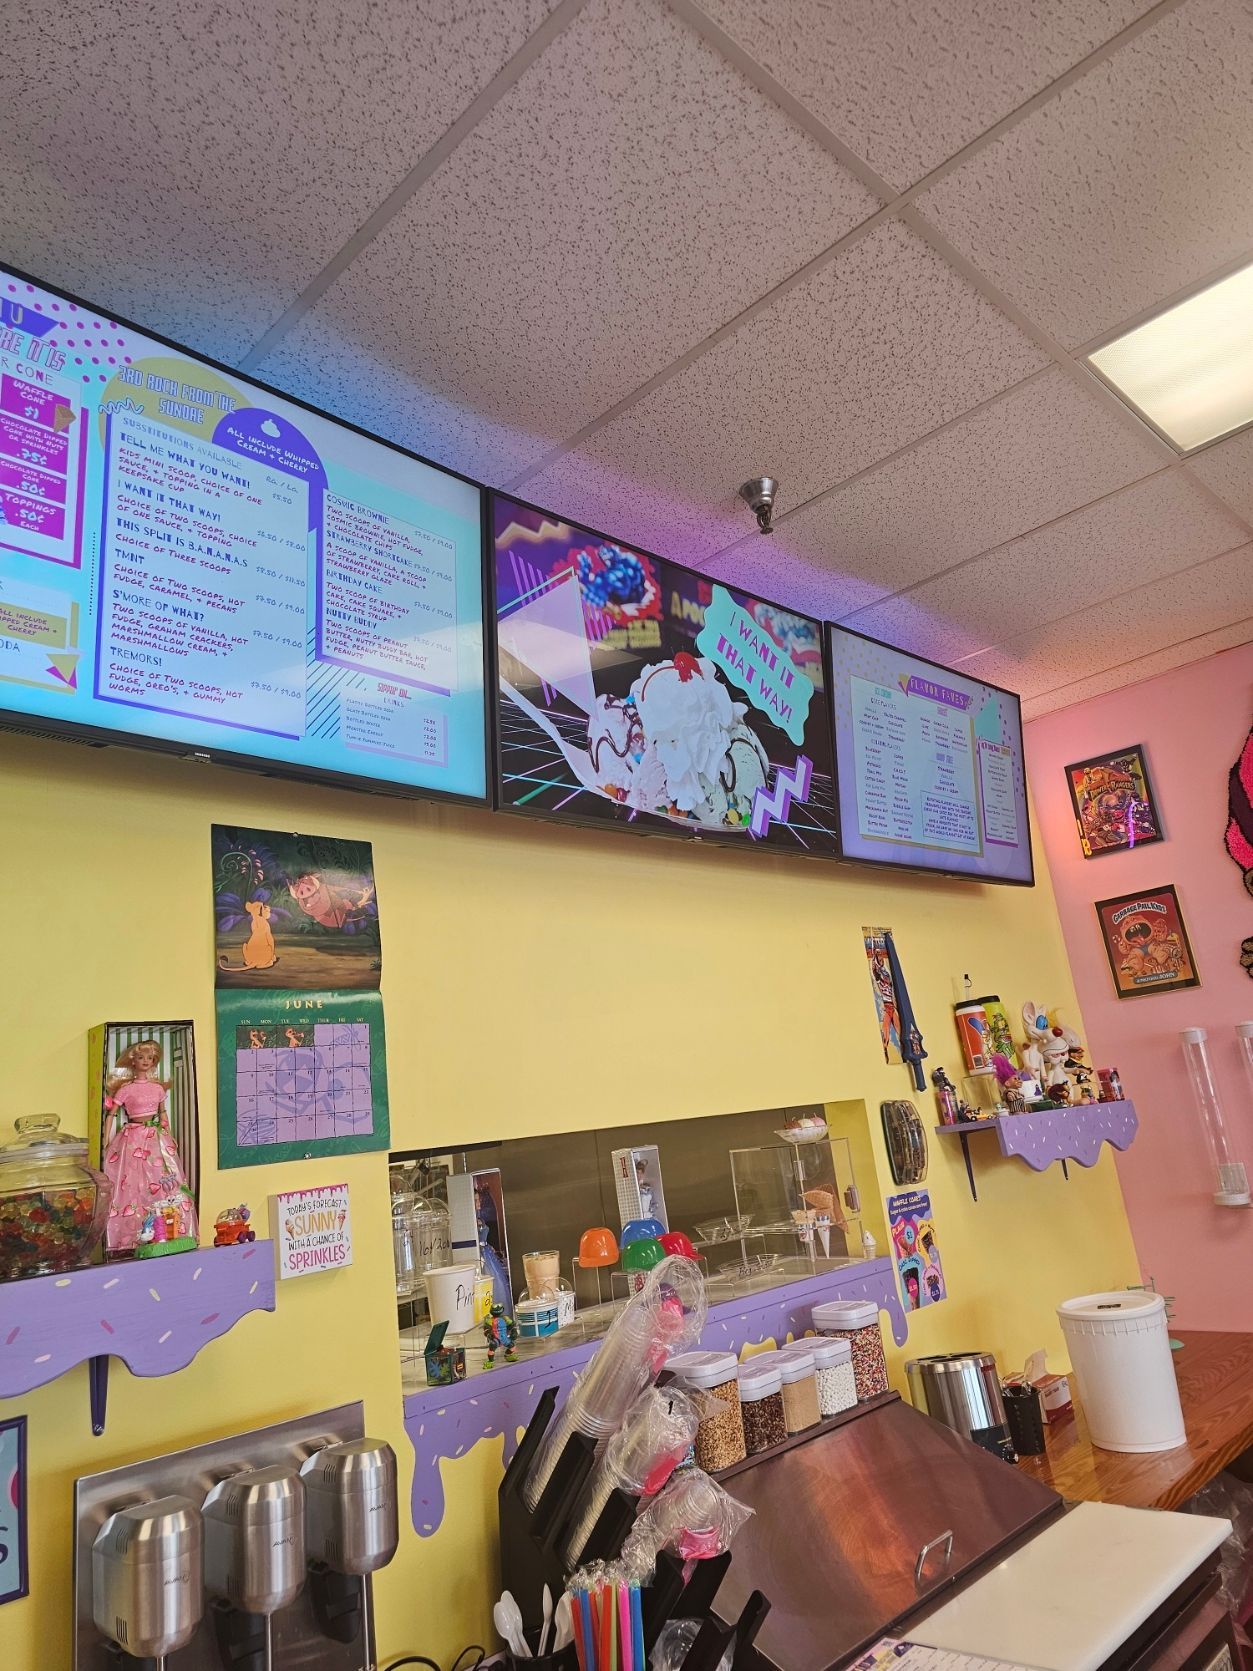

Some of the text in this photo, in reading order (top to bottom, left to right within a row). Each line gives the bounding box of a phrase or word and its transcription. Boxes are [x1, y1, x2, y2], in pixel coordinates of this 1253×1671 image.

[45, 347, 66, 371] IS
[16, 363, 54, 385] CONE
[13, 380, 54, 401] WAFFLE
[20, 391, 45, 406] CONE
[119, 364, 236, 414] 3RD ROCK FROM THE
[24, 405, 39, 420] $1
[159, 397, 205, 425] SUNDAE
[3, 425, 44, 445] CONE WITH
[21, 438, 59, 456] SPRINKLES
[44, 433, 68, 447] DIPPED
[122, 416, 243, 469] SUBSTITUTIONS AVAILABLE
[119, 431, 251, 490] TELL ME WHAT YOU WANT!
[227, 426, 320, 471] ALL INCLUDE WHIPPED
[236, 440, 309, 474] CREAM CHERRY
[0, 460, 62, 485] CHOCOLATE DIPPED
[22, 473, 39, 483] CONE
[118, 456, 200, 490] SAUCE, TOPPING
[118, 465, 185, 493] KEEPSAKE CUP
[119, 447, 263, 506] KIDS MINI SCOOP, CHOICE OF ONE
[5, 492, 57, 515] TOPPINGS
[124, 480, 221, 523] WANT IT THAT WAY!
[326, 494, 390, 525] COSMIC BROWNIE
[20, 521, 40, 531] EACH
[116, 504, 233, 548] OF ONE SAUCE, TOPPING
[117, 494, 257, 548] CHOICE TWO SCOOPS, CHOICE
[326, 514, 352, 528] COSMIC
[327, 505, 371, 526] TWO SCOOPS
[116, 517, 185, 547] THIS SPLIT IS
[334, 525, 393, 550] CHOCOLATE CHIPS
[114, 548, 145, 565] TMNT
[115, 533, 231, 575] CHOICE OF THREE SCOOPS
[326, 530, 413, 568] STRAWBERRY SHORTCAKE
[326, 558, 392, 586] STRAWBERRY GLAZE
[335, 545, 357, 557] SCOOP
[407, 571, 427, 582] SCOOP
[112, 573, 238, 614] FUDGE, CARAMEL, PECANS
[113, 563, 246, 608] CHOICE OF TWO SCOOPS, HOT
[326, 568, 383, 595] BIRTHDAY CAKE
[112, 588, 205, 623] S'MORE WHAT?
[326, 581, 343, 592] TWO
[345, 589, 367, 600] SCOOP
[380, 600, 410, 614] BIRTHDAY
[326, 599, 388, 622] CHOCOLATE SYRUP
[7, 624, 37, 636] CHERRY
[16, 613, 47, 625] INCLUDE
[23, 621, 50, 632] CREAM
[112, 602, 249, 646] TWO SCOOPS OF VANILLA, HOT
[110, 632, 190, 657] MARSHMALLOWS
[111, 613, 233, 653] FUDGE, GRAHAM CRACKERS,
[111, 622, 219, 658] MARSHMALLOW CREAM,
[325, 619, 343, 630] TWO
[345, 625, 371, 638] SCOOPS
[383, 637, 408, 648] PEANUT
[355, 637, 376, 647] NUTTY
[109, 646, 163, 667] TREMORS!
[333, 646, 365, 660] PEANUTS
[352, 643, 403, 663] PEANUT BUTTER
[739, 619, 779, 672] WANT
[780, 666, 796, 689] IT
[108, 672, 226, 704] FUDGE, GUMMY
[108, 682, 146, 697] WORMS
[109, 663, 244, 699] CHOICE OF TWO SCOOPS, HOT
[716, 632, 793, 724] THAT WAY!
[1113, 904, 1137, 922] GARBAGE
[1137, 902, 1152, 911] PAIL
[285, 999, 324, 1010] JUNE
[287, 1199, 342, 1216] TODAY'S FORECAST
[294, 1210, 338, 1236] SUNNY
[288, 1231, 344, 1250] WITH A CHANCE OF
[288, 1244, 346, 1270] SPRINKLES
